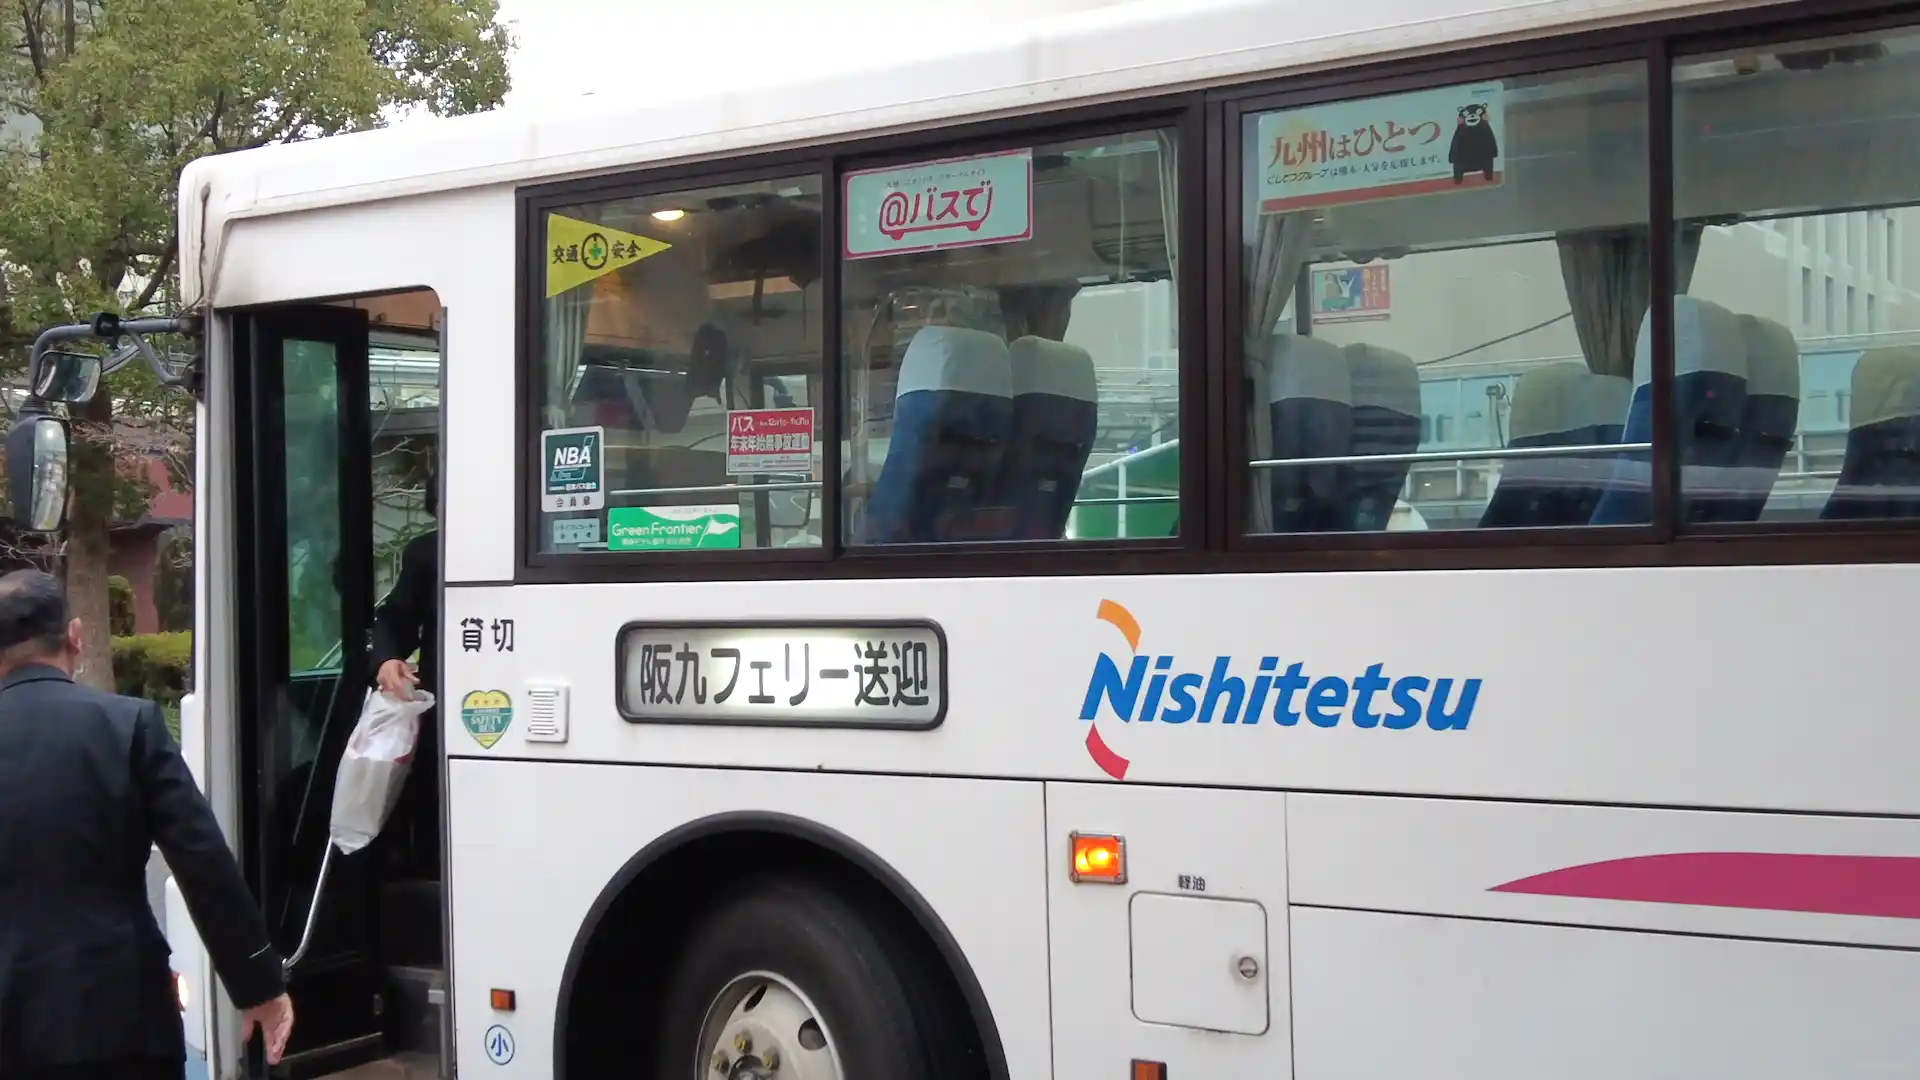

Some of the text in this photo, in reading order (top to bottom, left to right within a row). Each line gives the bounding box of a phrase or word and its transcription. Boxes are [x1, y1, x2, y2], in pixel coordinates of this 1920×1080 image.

[1267, 120, 1442, 169] 九州はひとつ
[552, 239, 642, 265] 交通 安全
[731, 415, 755, 433] バス
[554, 445, 591, 467] NBA
[611, 522, 650, 537] Green
[651, 521, 703, 535] Frontier
[460, 616, 516, 653] 貸切
[639, 638, 930, 708] 阪九フェリー送迎
[1079, 651, 1483, 732] Nishitetsu
[470, 715, 502, 725] SAFETY
[1177, 871, 1206, 892] 軽油
[490, 1031, 509, 1057] 小
